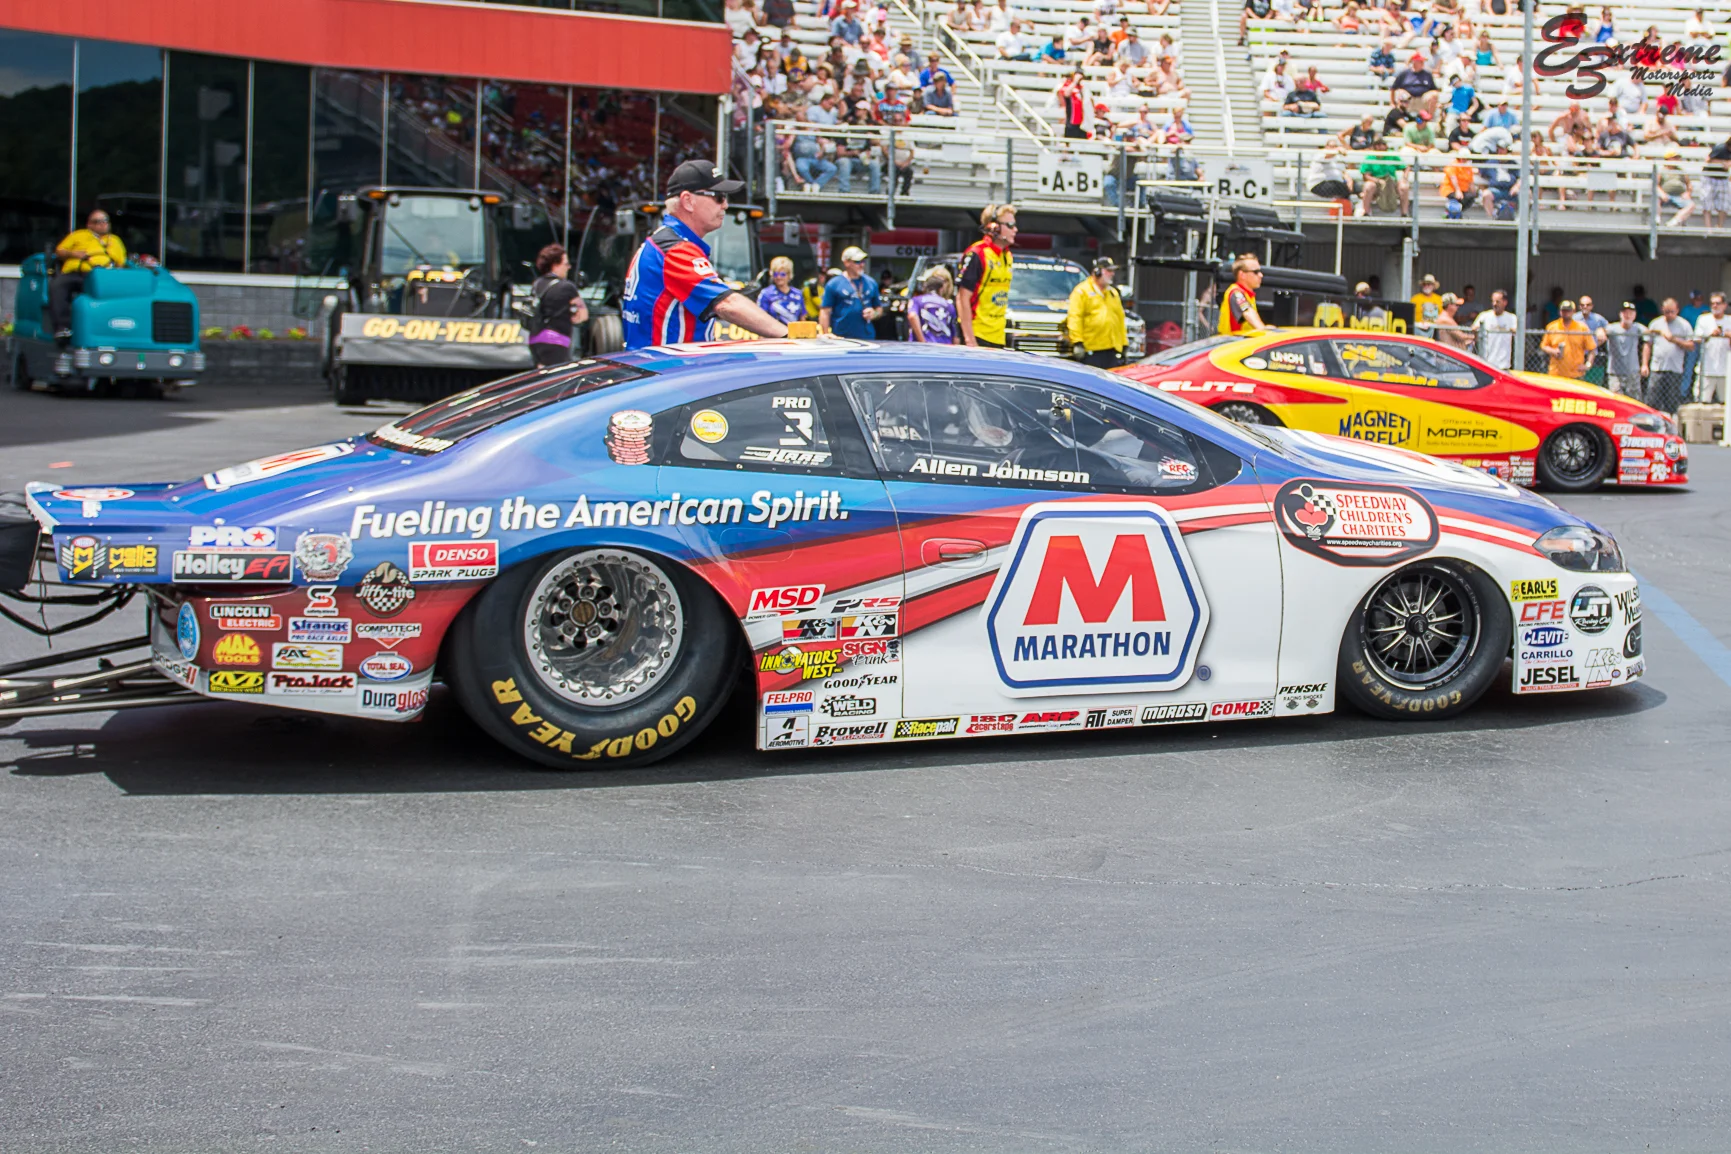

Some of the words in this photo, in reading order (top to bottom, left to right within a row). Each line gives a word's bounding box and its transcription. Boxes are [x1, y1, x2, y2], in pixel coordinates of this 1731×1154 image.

[1157, 381, 1257, 394] ELITE
[772, 396, 812, 409] PRO
[779, 411, 814, 446] 3
[1427, 428, 1498, 439] MOPAR
[909, 457, 978, 477] Allen
[981, 461, 1091, 485] Johnson
[1336, 493, 1407, 511] SPEEDWAY
[350, 500, 494, 540] Fueling
[501, 496, 561, 531] the
[564, 493, 743, 528] American
[748, 490, 849, 528] Spirit.
[1339, 510, 1413, 524] CHILDREN'S
[190, 525, 275, 547] PRO
[1342, 523, 1406, 537] CHARITIES
[1326, 539, 1403, 548] www.speedwaycharities.org
[435, 548, 489, 562] DENSO
[175, 553, 246, 581] Holley
[243, 555, 290, 579] EFI
[413, 569, 452, 579] SPARK
[457, 567, 497, 577] PLUGS
[1022, 534, 1167, 626] M
[355, 585, 416, 600] Jiffy-tite
[1520, 580, 1557, 595] EARL'S
[752, 587, 821, 611] MSD
[213, 606, 269, 617] LINCOLN
[1520, 600, 1566, 622] CFE
[226, 619, 276, 627] ELECTRIC
[292, 620, 348, 631] Strange
[357, 625, 420, 633] COMPUTECH
[1522, 630, 1569, 645] CLEVITE
[844, 641, 887, 656] SIGN
[1013, 631, 1172, 662] MARATHON
[216, 655, 260, 663] TOOLS
[853, 654, 888, 666] Punk
[1521, 650, 1573, 660] CARRILLO
[366, 662, 387, 671] TOTAL
[389, 662, 406, 671] SEAL
[802, 664, 836, 680] WEST
[1520, 666, 1580, 685] JESEL
[1279, 683, 1328, 695] PENSKE
[767, 691, 812, 704] FEL-PRO
[833, 699, 875, 710] WELD
[833, 709, 875, 717] RACING
[1112, 709, 1133, 717] SUPER
[1141, 703, 1207, 724] MOROSO
[1211, 701, 1260, 716] COMP
[1020, 711, 1080, 723] ARP
[1085, 709, 1107, 728] ATI
[1106, 717, 1134, 726] DAMPER
[816, 722, 888, 739] Browell
[909, 719, 957, 735] Racepak
[971, 722, 997, 731] racers
[998, 721, 1014, 731] tape
[767, 738, 806, 748] AEROMOTIVE
